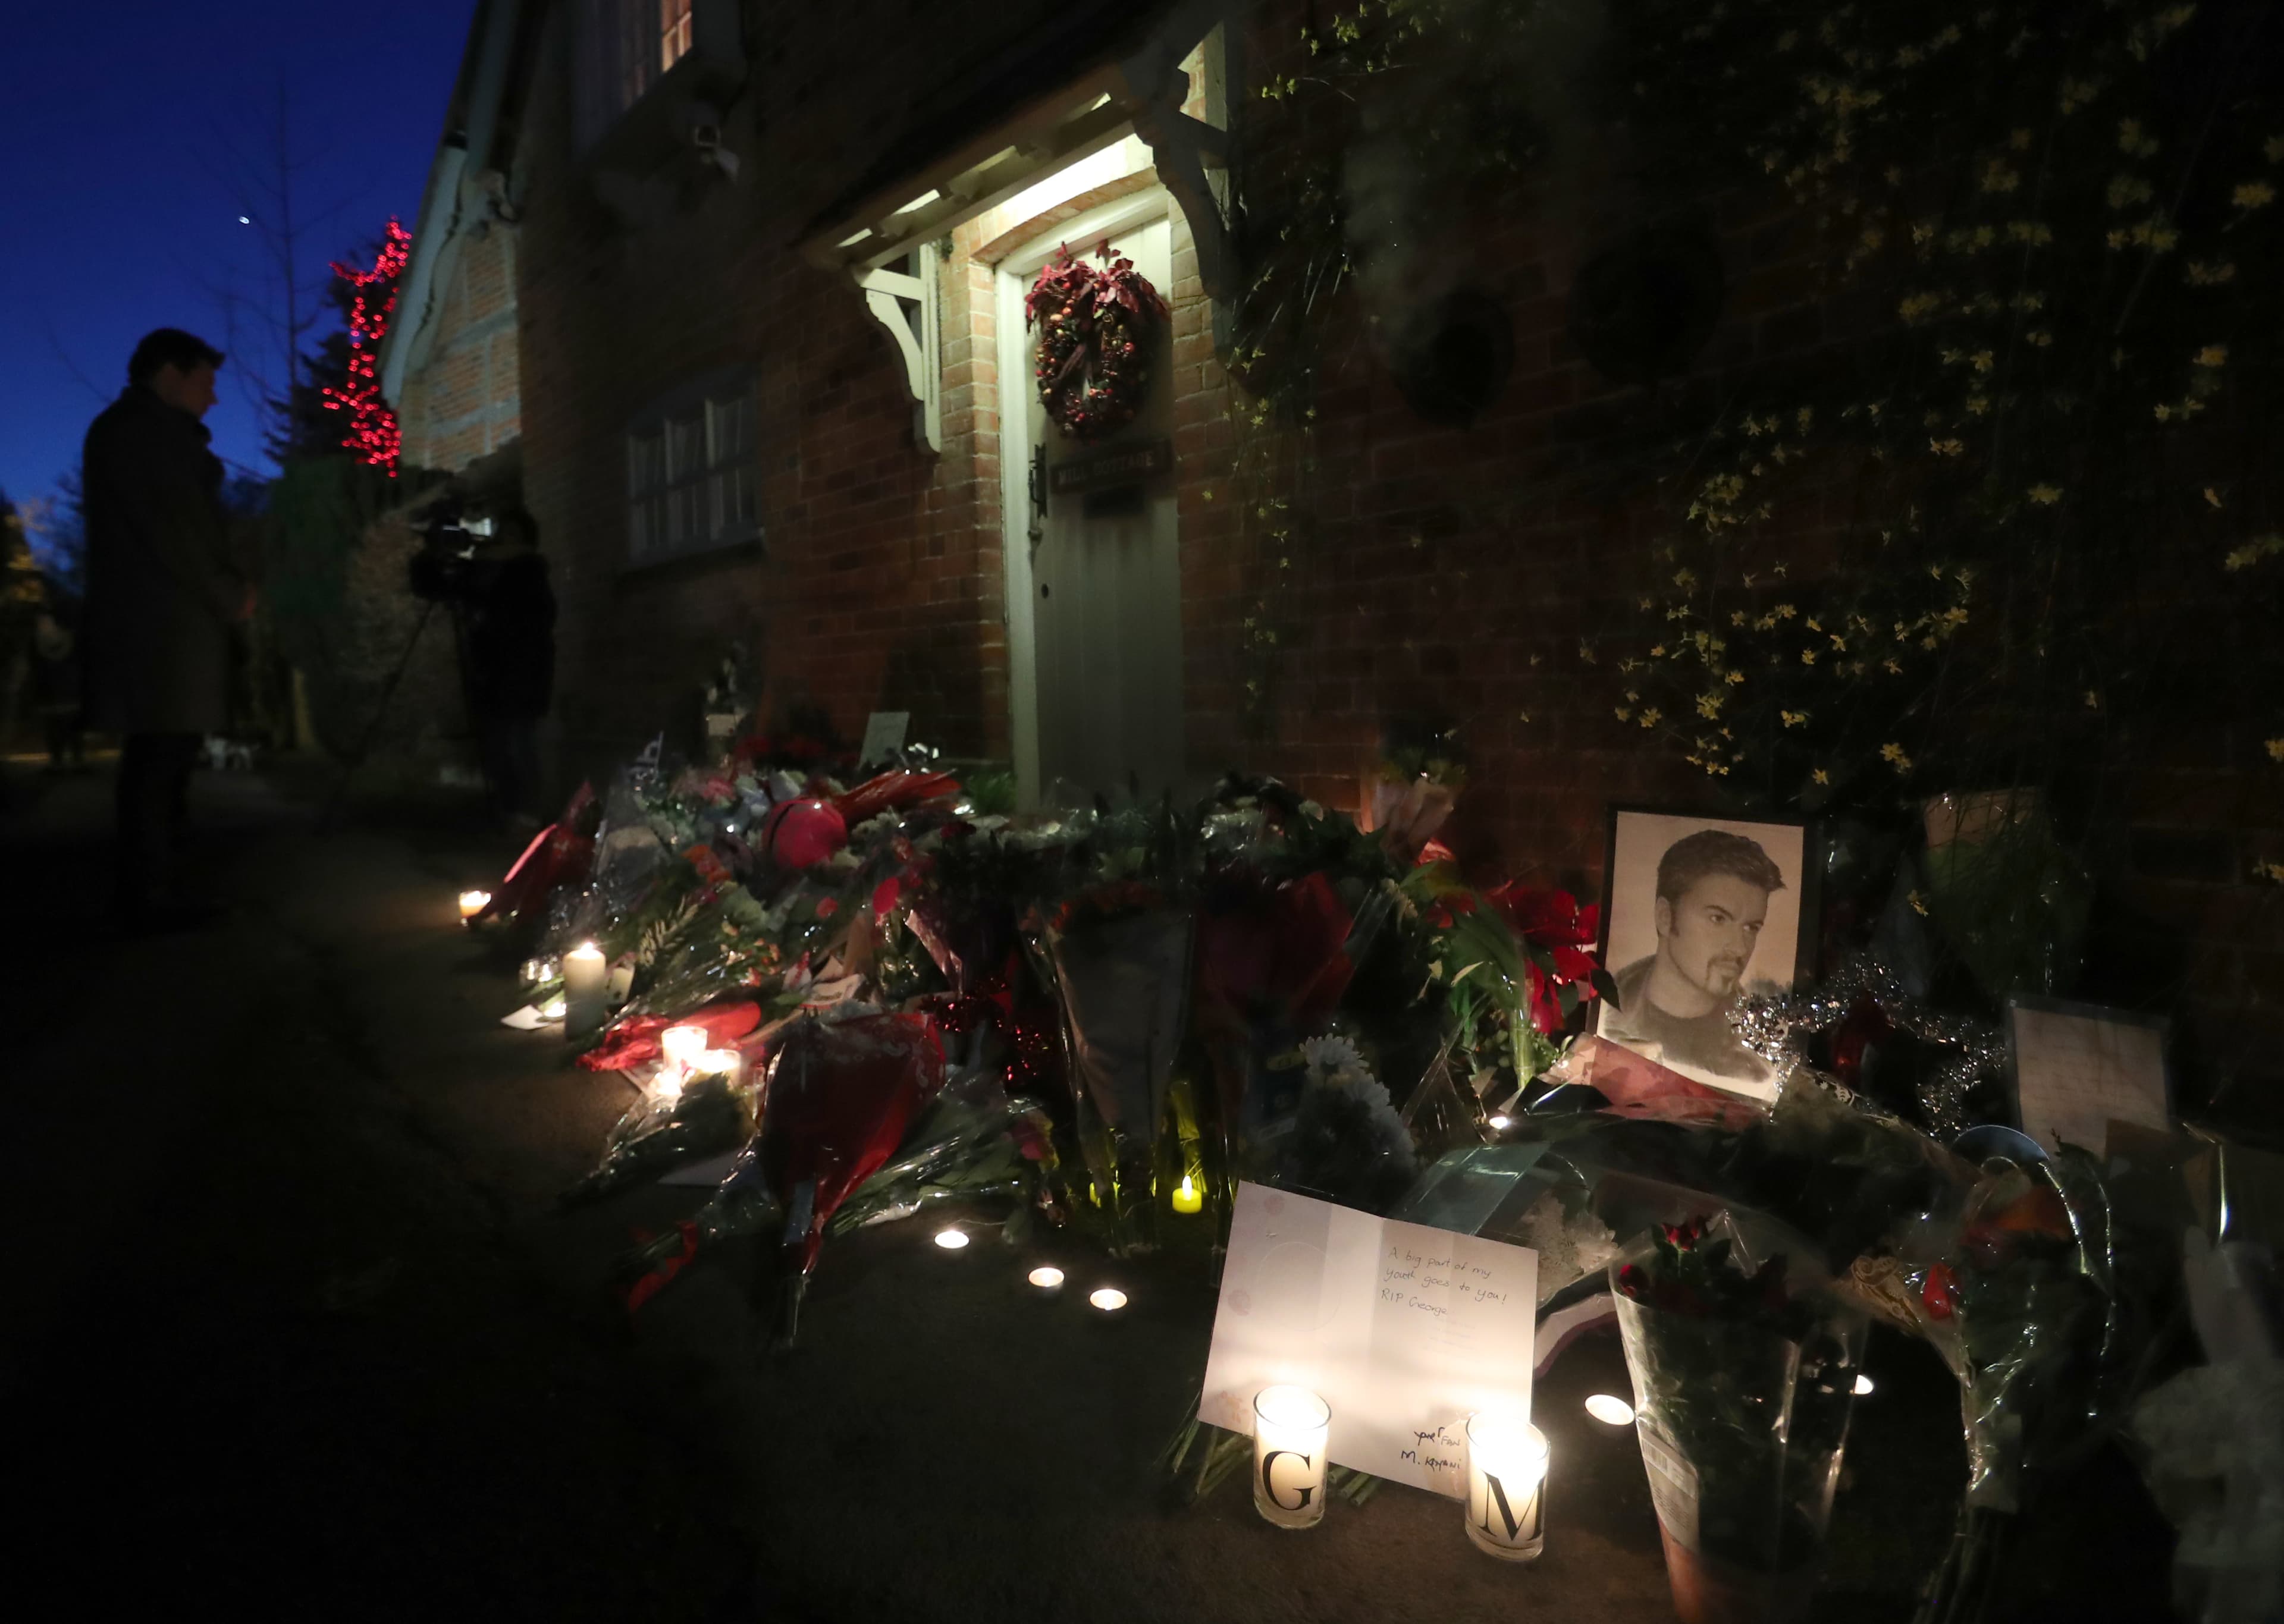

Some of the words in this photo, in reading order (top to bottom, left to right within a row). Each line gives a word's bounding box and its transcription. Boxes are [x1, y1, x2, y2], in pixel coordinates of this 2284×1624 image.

[1388, 1246, 1398, 1259] A
[1405, 1250, 1422, 1268] big
[1427, 1256, 1451, 1268] part
[1454, 1262, 1468, 1270] of
[1472, 1267, 1492, 1279] my
[1381, 1288, 1404, 1303] RIP
[1408, 1296, 1447, 1317] George
[1383, 1267, 1415, 1281] youth
[1422, 1276, 1450, 1287] goes
[1459, 1281, 1470, 1291] to
[1474, 1289, 1507, 1304] you!
[1262, 1450, 1317, 1511] G
[1478, 1469, 1545, 1541] M
